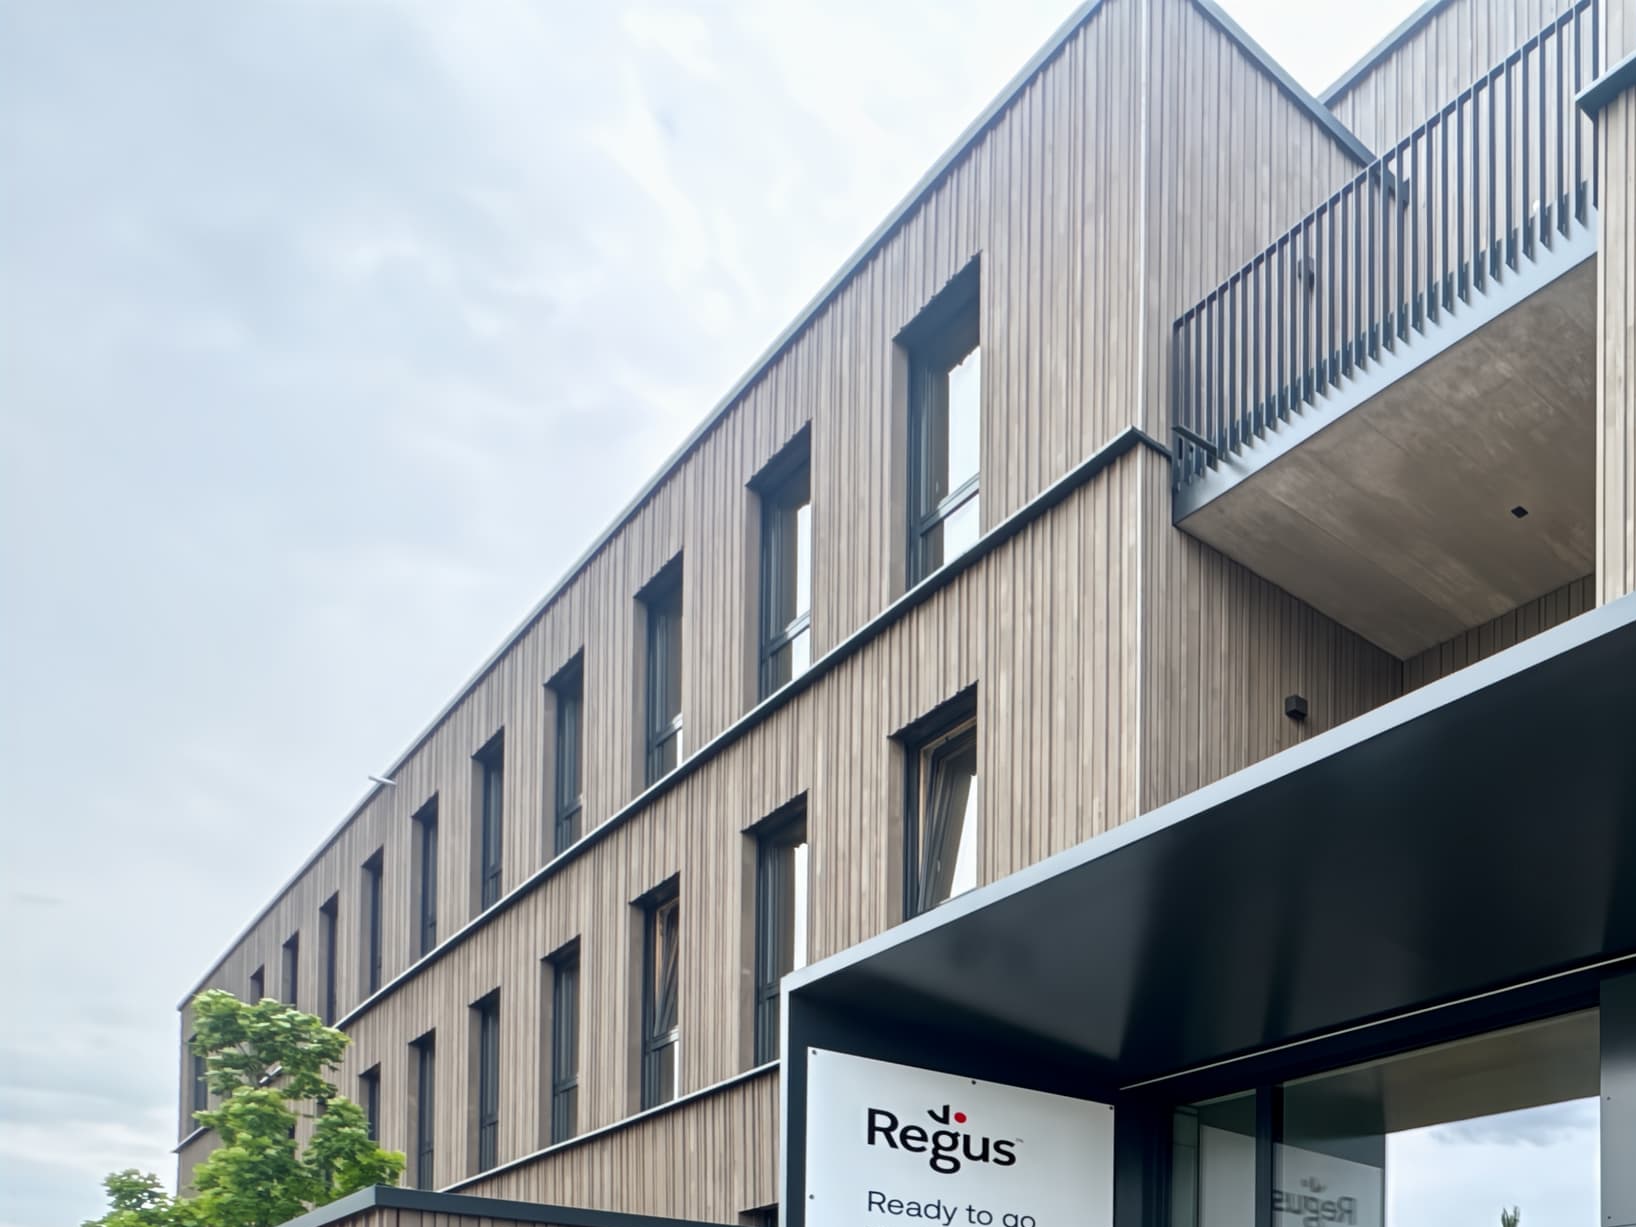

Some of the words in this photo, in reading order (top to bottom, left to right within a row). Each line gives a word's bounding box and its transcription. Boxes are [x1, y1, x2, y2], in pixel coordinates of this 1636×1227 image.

[867, 1107, 1016, 1174] Regus
[867, 1190, 958, 1227] Ready
[965, 1204, 993, 1225] to
